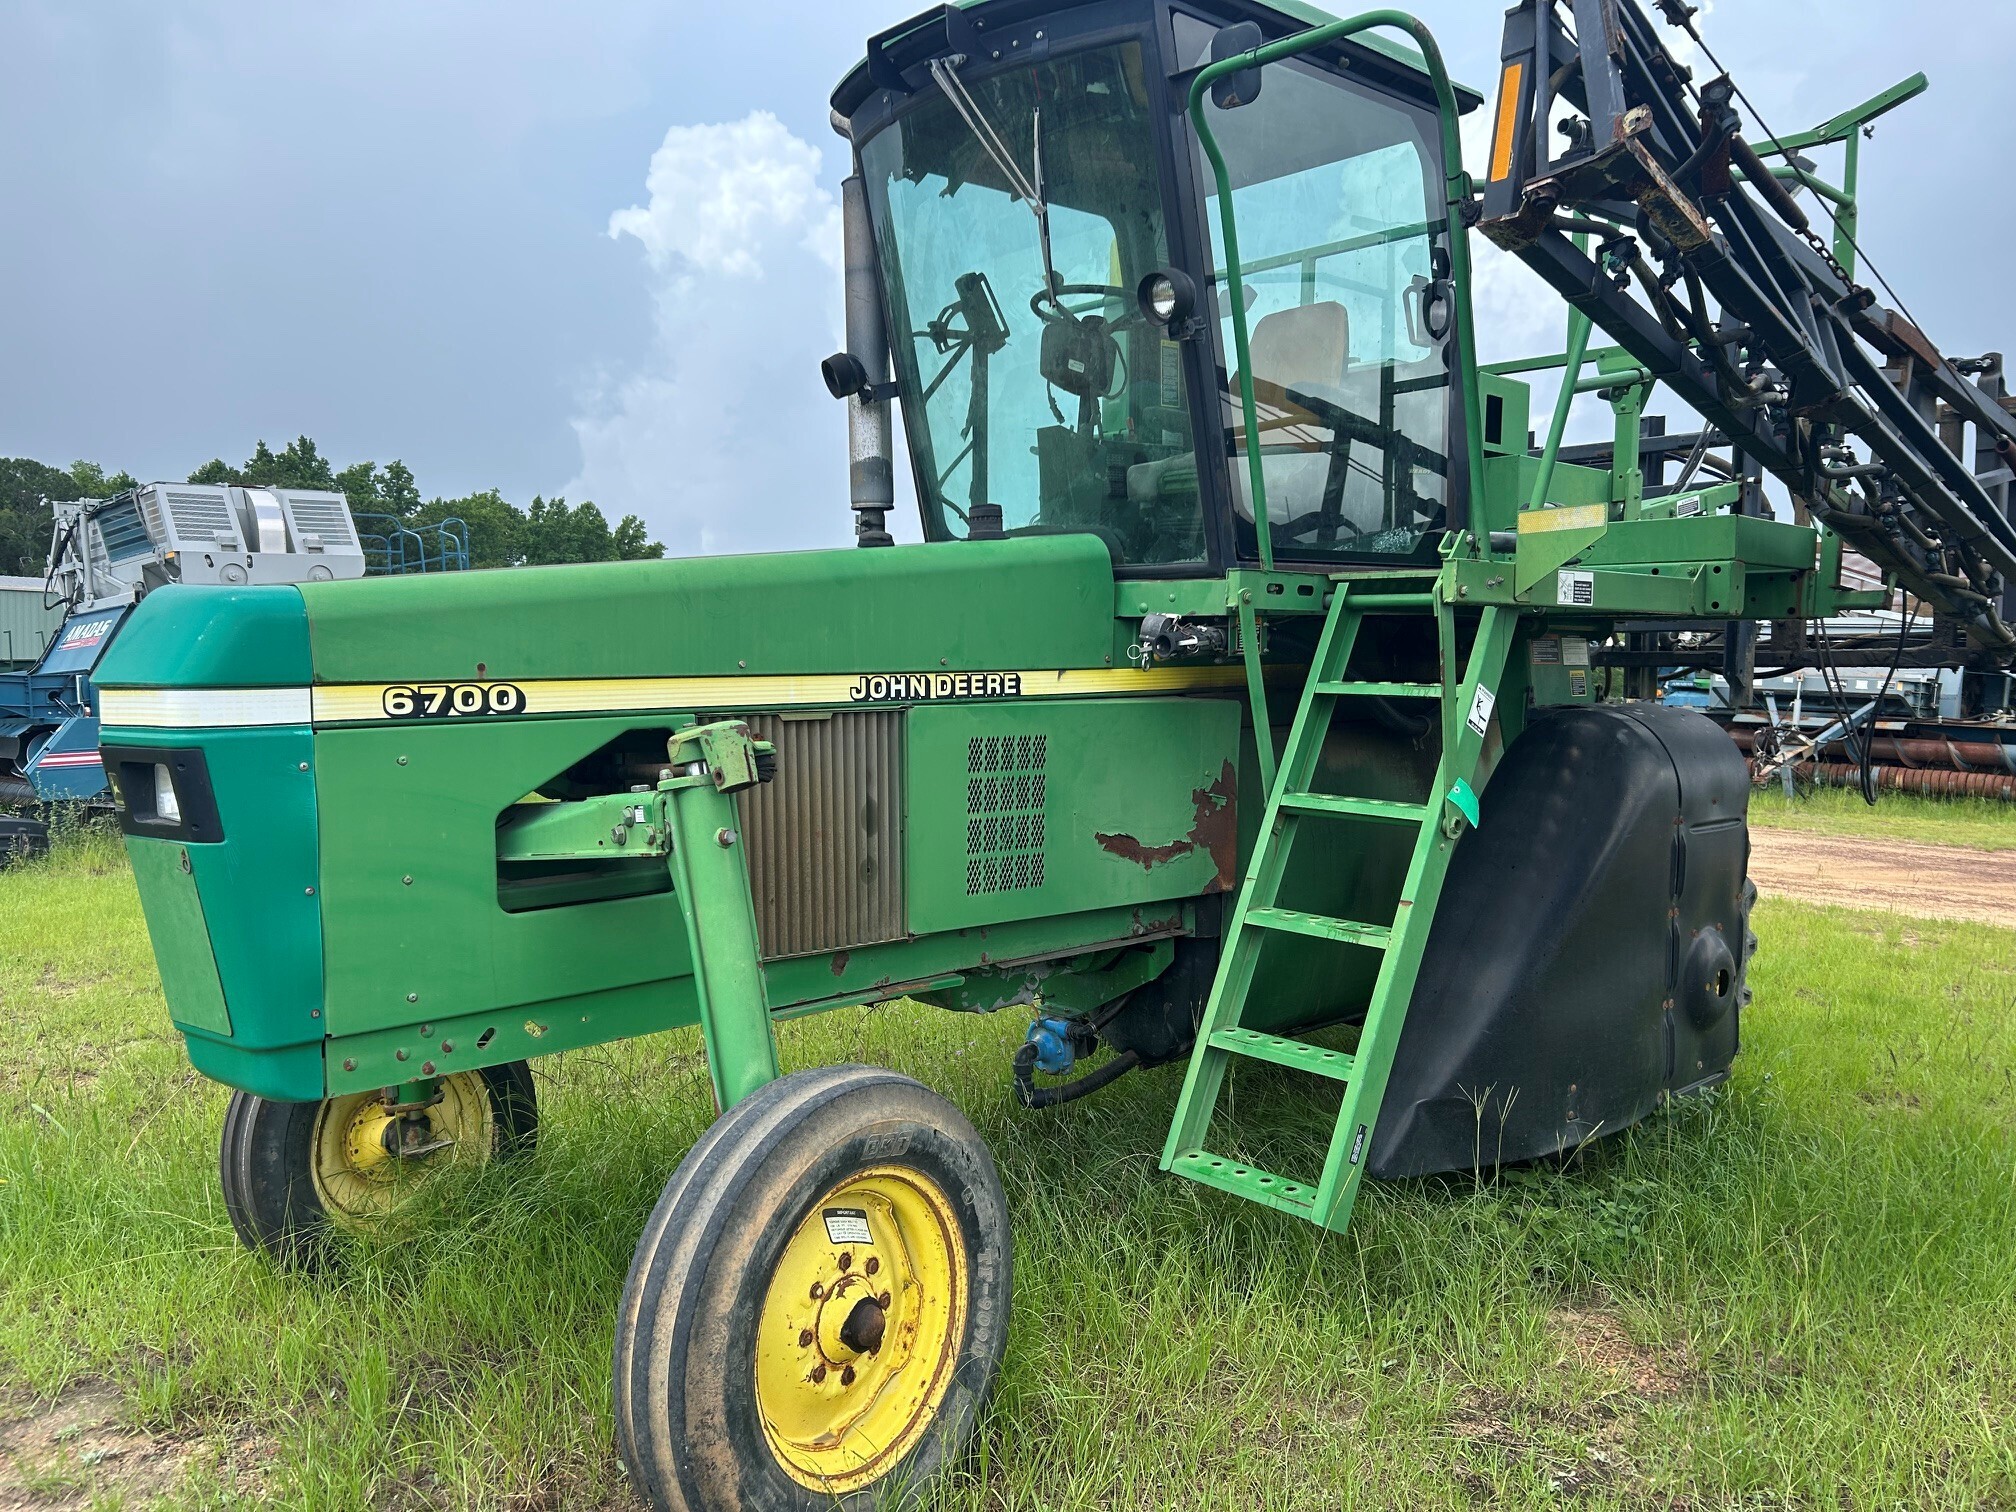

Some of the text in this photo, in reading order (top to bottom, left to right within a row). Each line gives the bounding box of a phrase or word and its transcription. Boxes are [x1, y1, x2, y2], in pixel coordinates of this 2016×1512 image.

[62, 619, 112, 642] AMADAS
[850, 672, 1022, 700] JOHN DEERE
[383, 683, 527, 718] 6700
[863, 1133, 912, 1158] BKT
